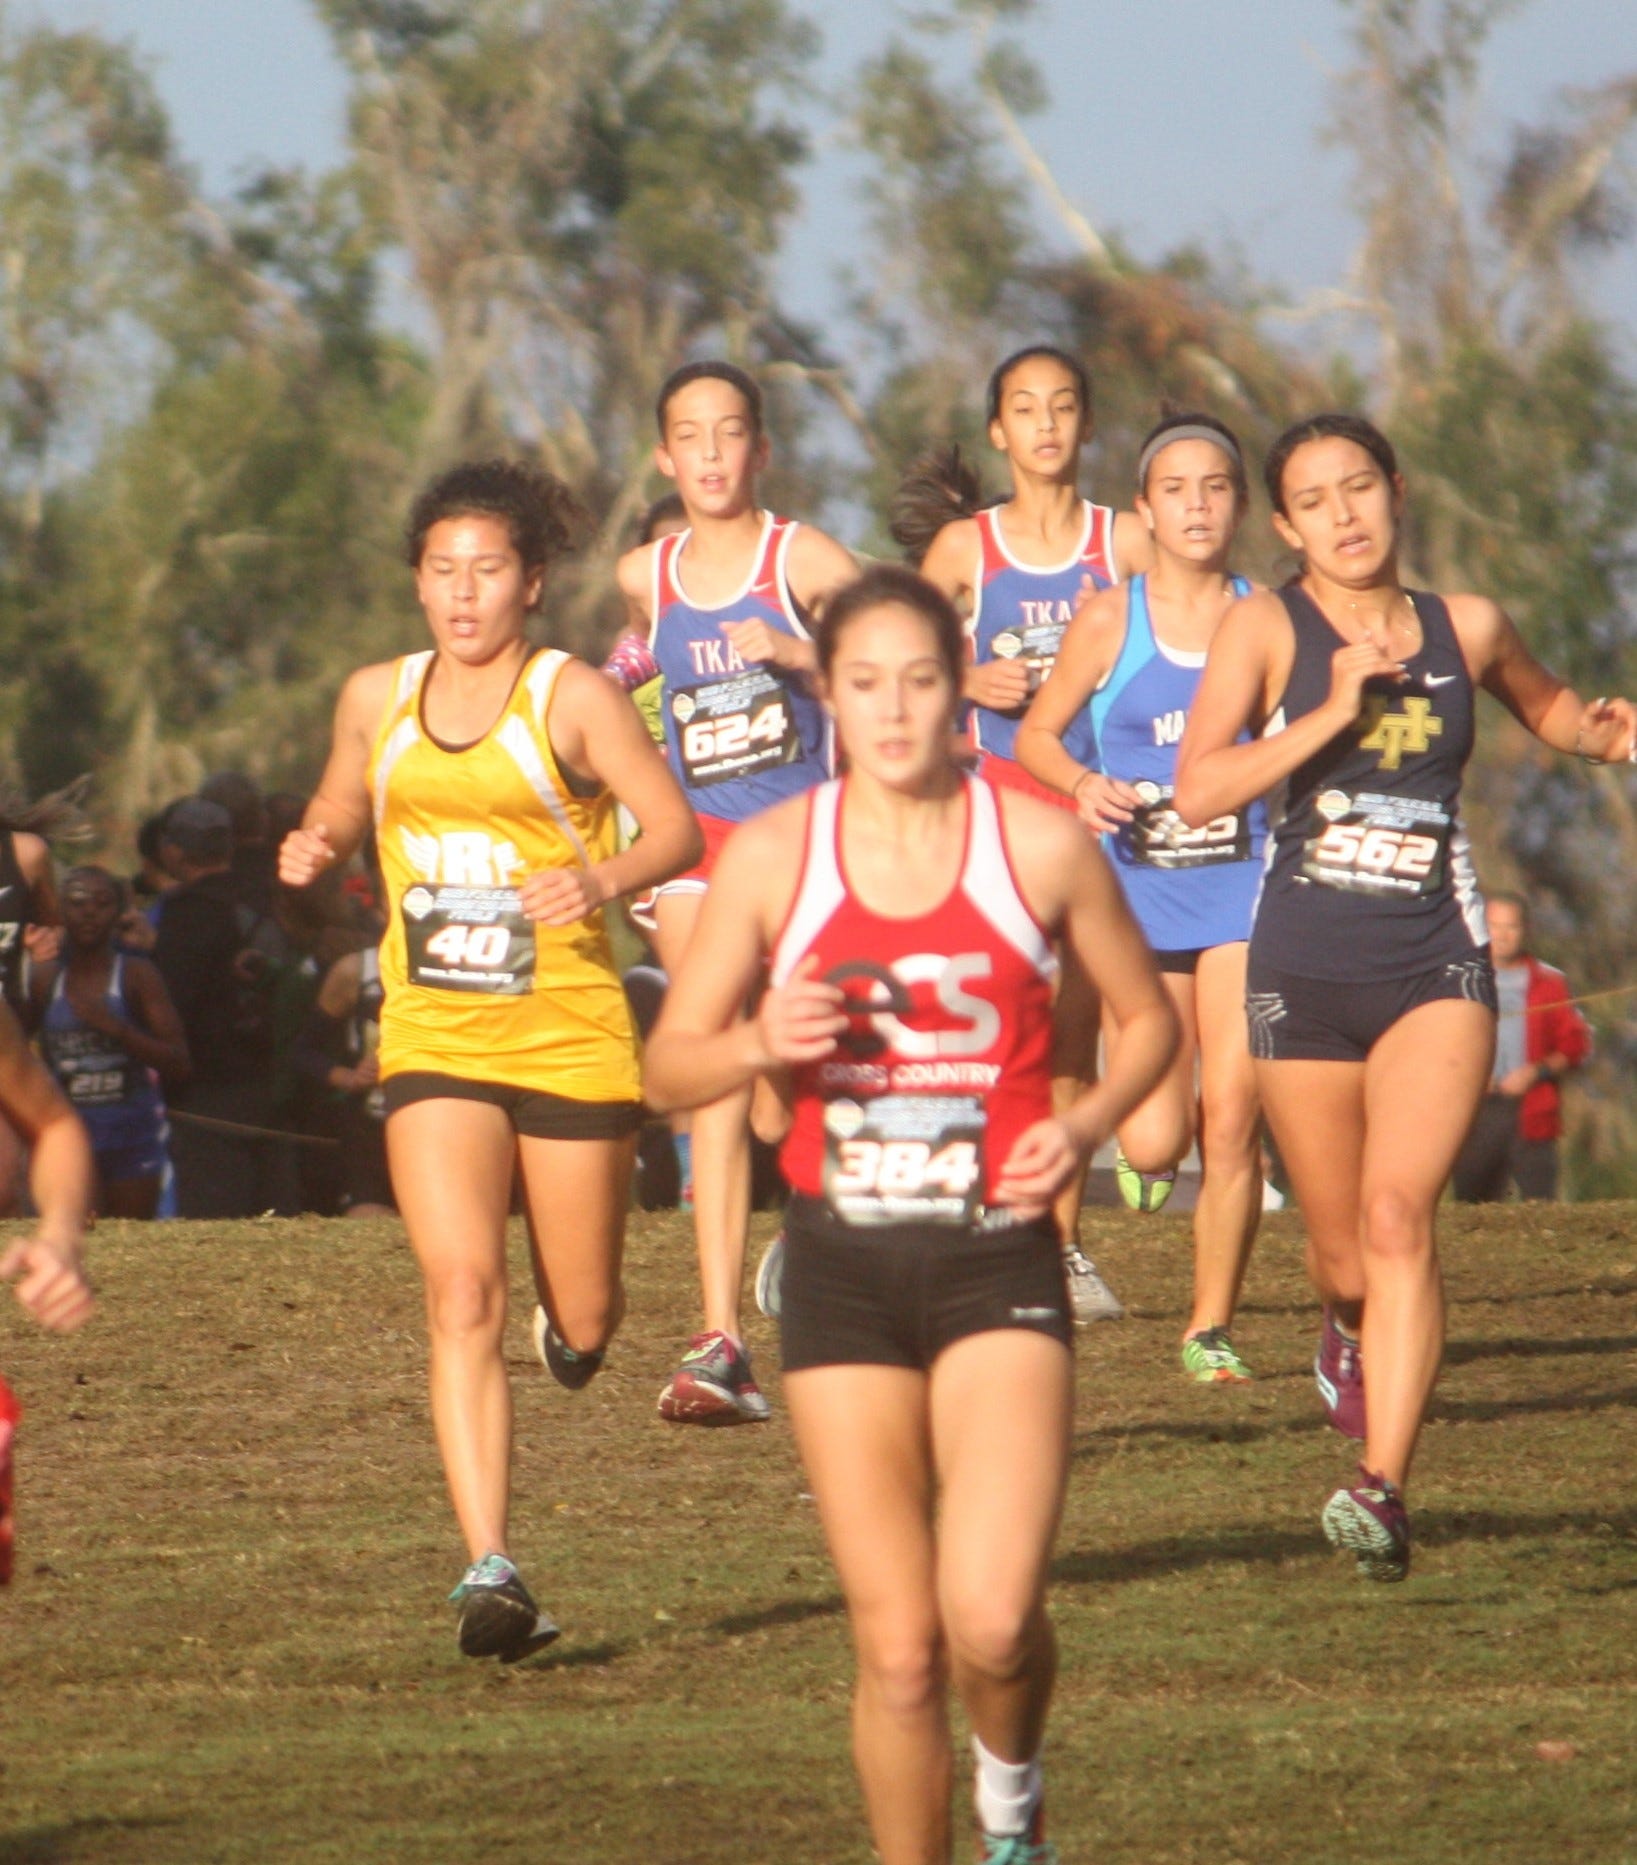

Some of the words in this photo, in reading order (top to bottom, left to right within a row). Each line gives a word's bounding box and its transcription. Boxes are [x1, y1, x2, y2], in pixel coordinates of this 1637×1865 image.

[685, 703, 788, 761] 624
[1316, 824, 1439, 877] 562
[427, 926, 511, 965] 40
[890, 1061, 1003, 1089] COUNTRY
[831, 1141, 980, 1194] 384
